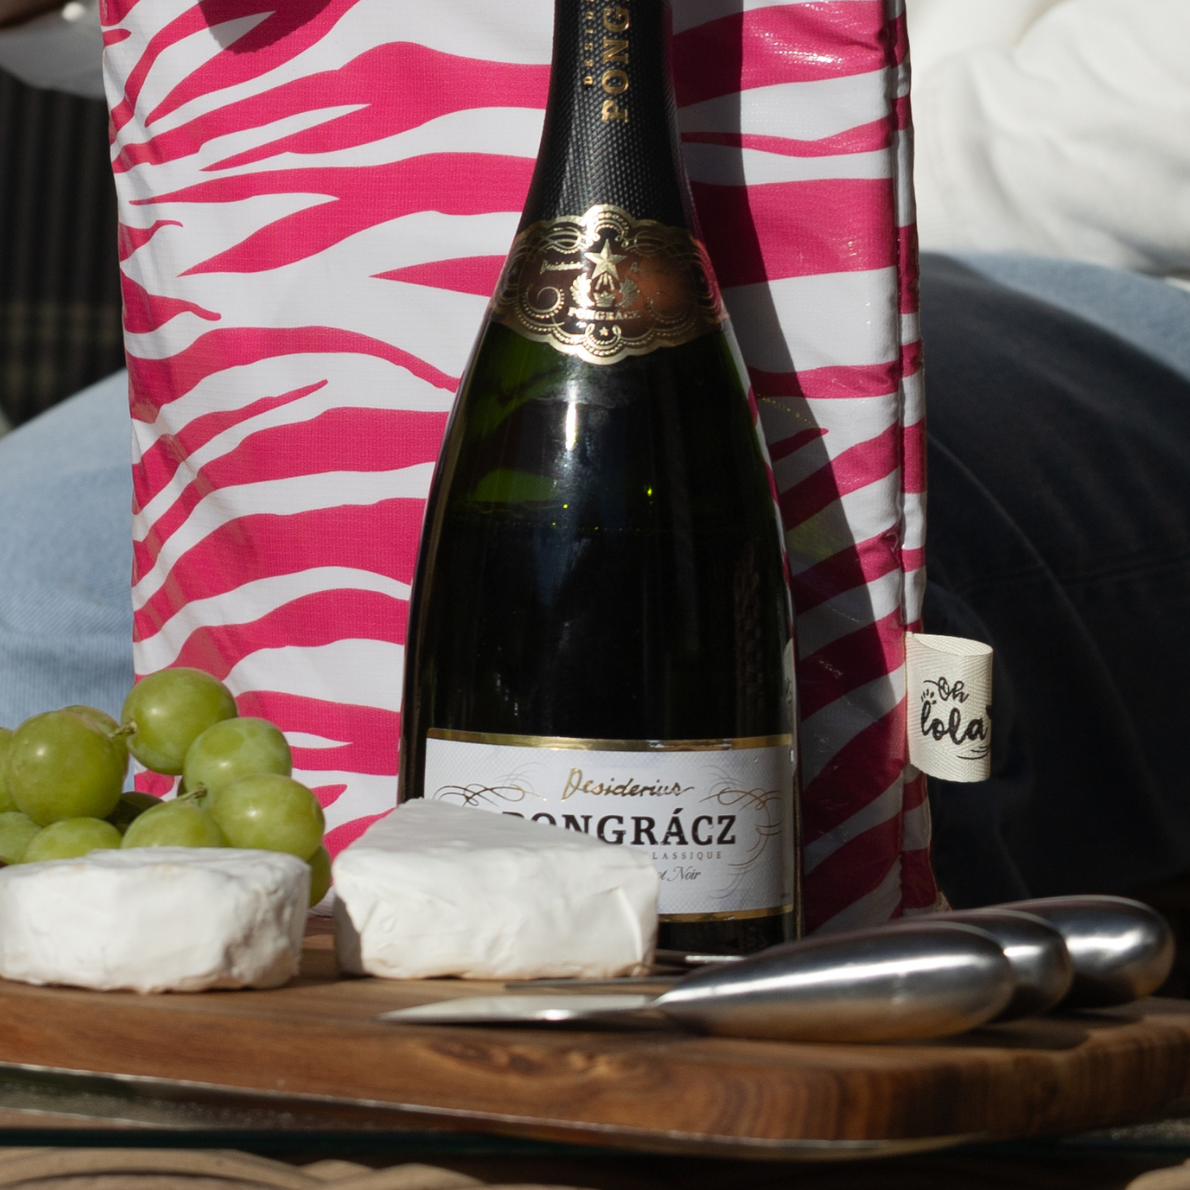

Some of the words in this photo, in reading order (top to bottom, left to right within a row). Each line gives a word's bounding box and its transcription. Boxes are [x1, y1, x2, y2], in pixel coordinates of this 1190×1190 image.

[923, 676, 970, 703] Oh
[920, 700, 989, 745] lola
[560, 767, 696, 803] Desiderius
[501, 808, 736, 846] NGRÁCZ
[652, 851, 722, 861] LASSIQUE
[667, 866, 702, 882] Noir
